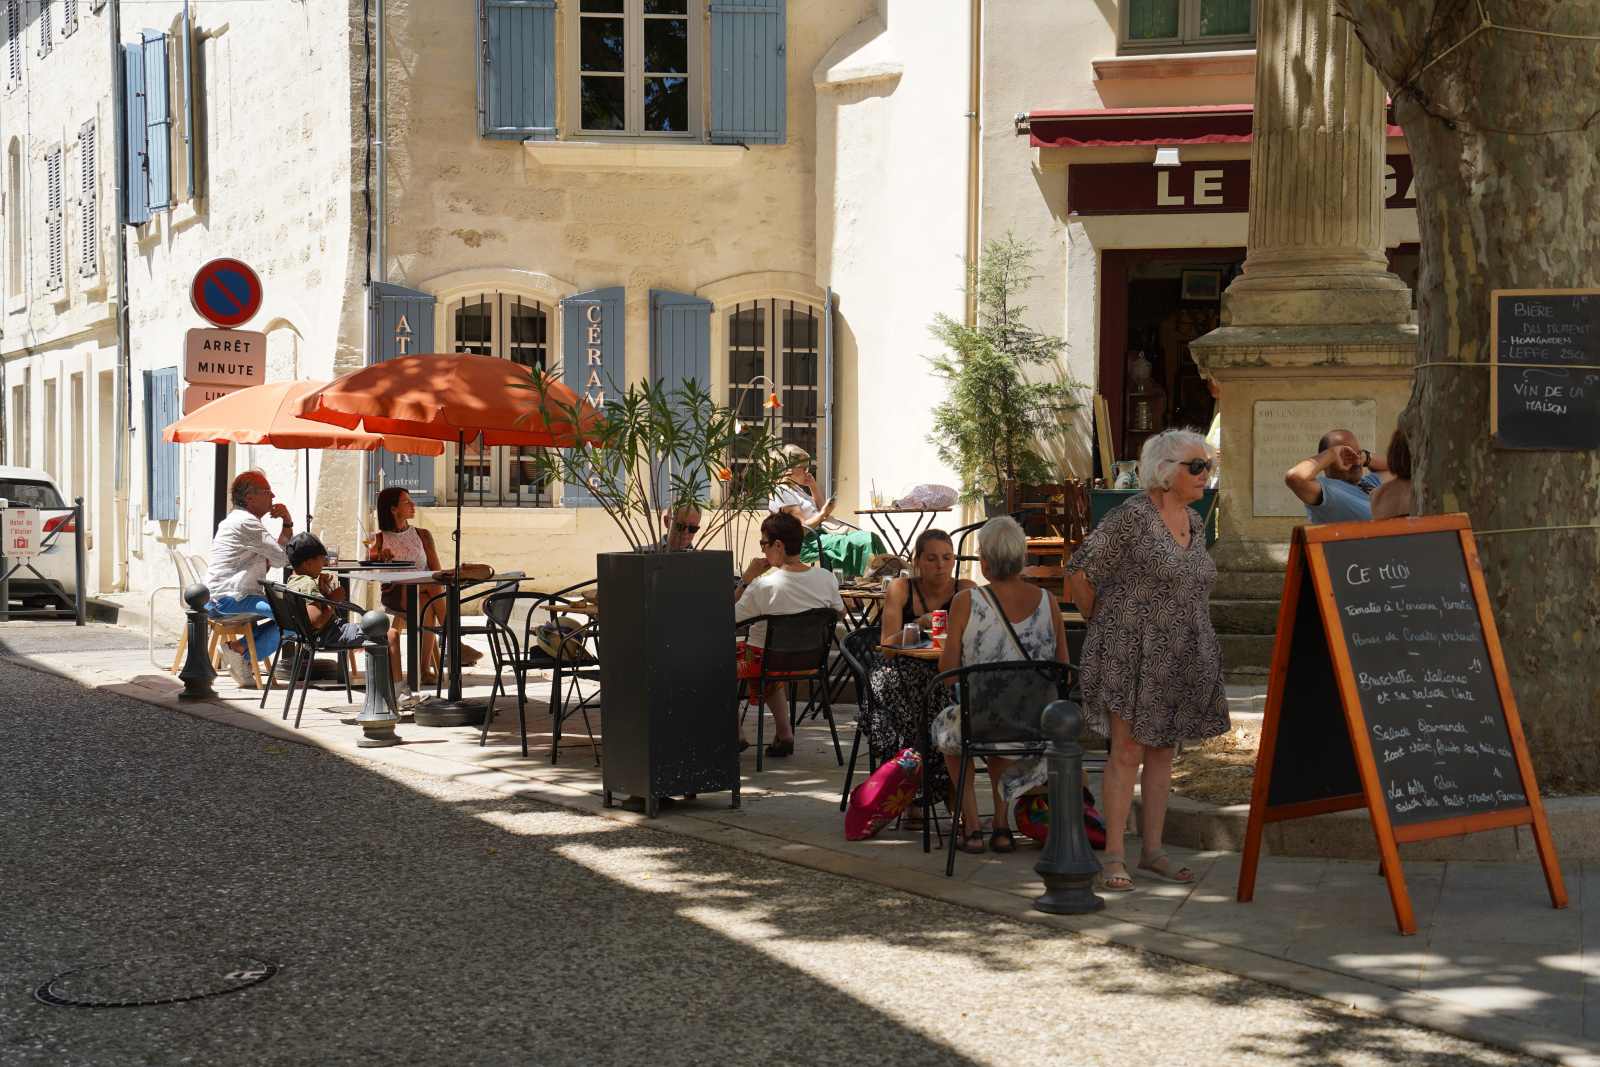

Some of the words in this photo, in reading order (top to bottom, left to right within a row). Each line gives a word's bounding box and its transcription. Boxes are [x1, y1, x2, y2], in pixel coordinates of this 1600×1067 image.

[1157, 169, 1224, 206] LE
[203, 339, 251, 352] ARRÊT
[198, 362, 254, 376] MINUTE
[1545, 386, 1563, 397] DE
